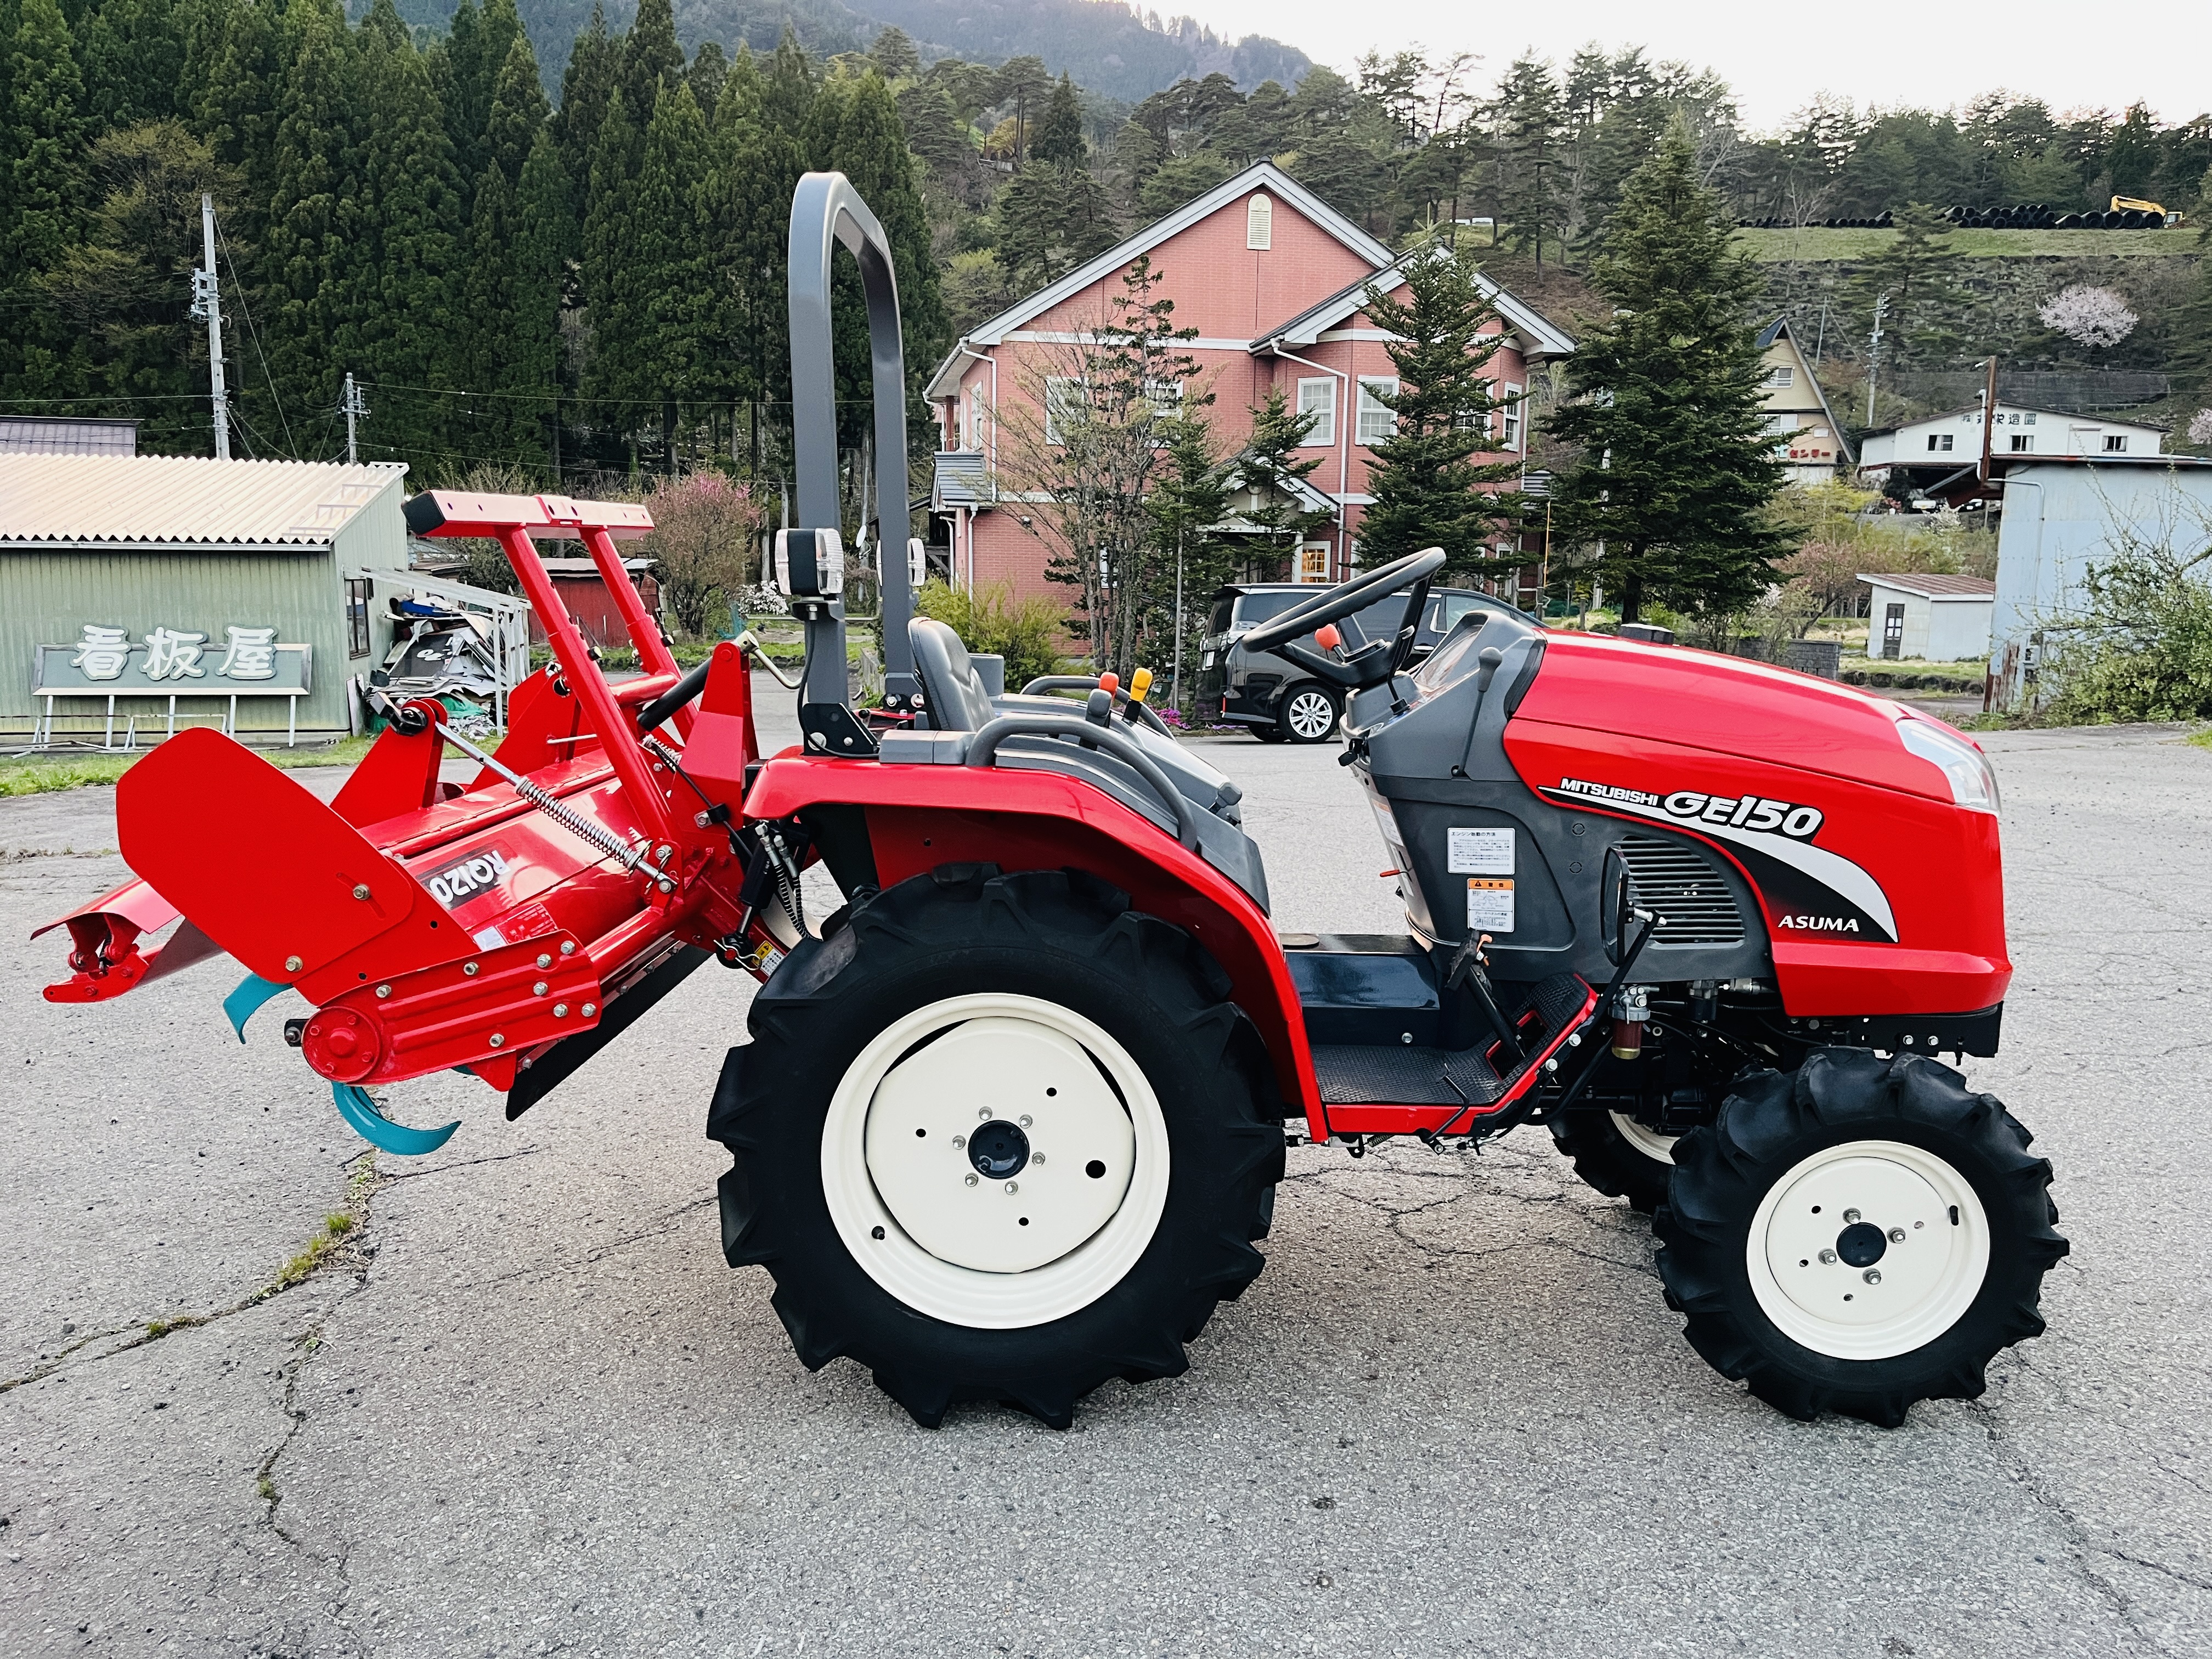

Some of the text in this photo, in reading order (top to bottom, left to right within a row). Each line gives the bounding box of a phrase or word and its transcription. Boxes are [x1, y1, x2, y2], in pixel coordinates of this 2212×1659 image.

[72, 624, 274, 678] 看板屋
[1560, 778, 1658, 806] MITSUBISHI
[1664, 791, 1822, 836] GE150
[429, 850, 511, 903] RQ120
[1778, 915, 1859, 932] ASUMA
